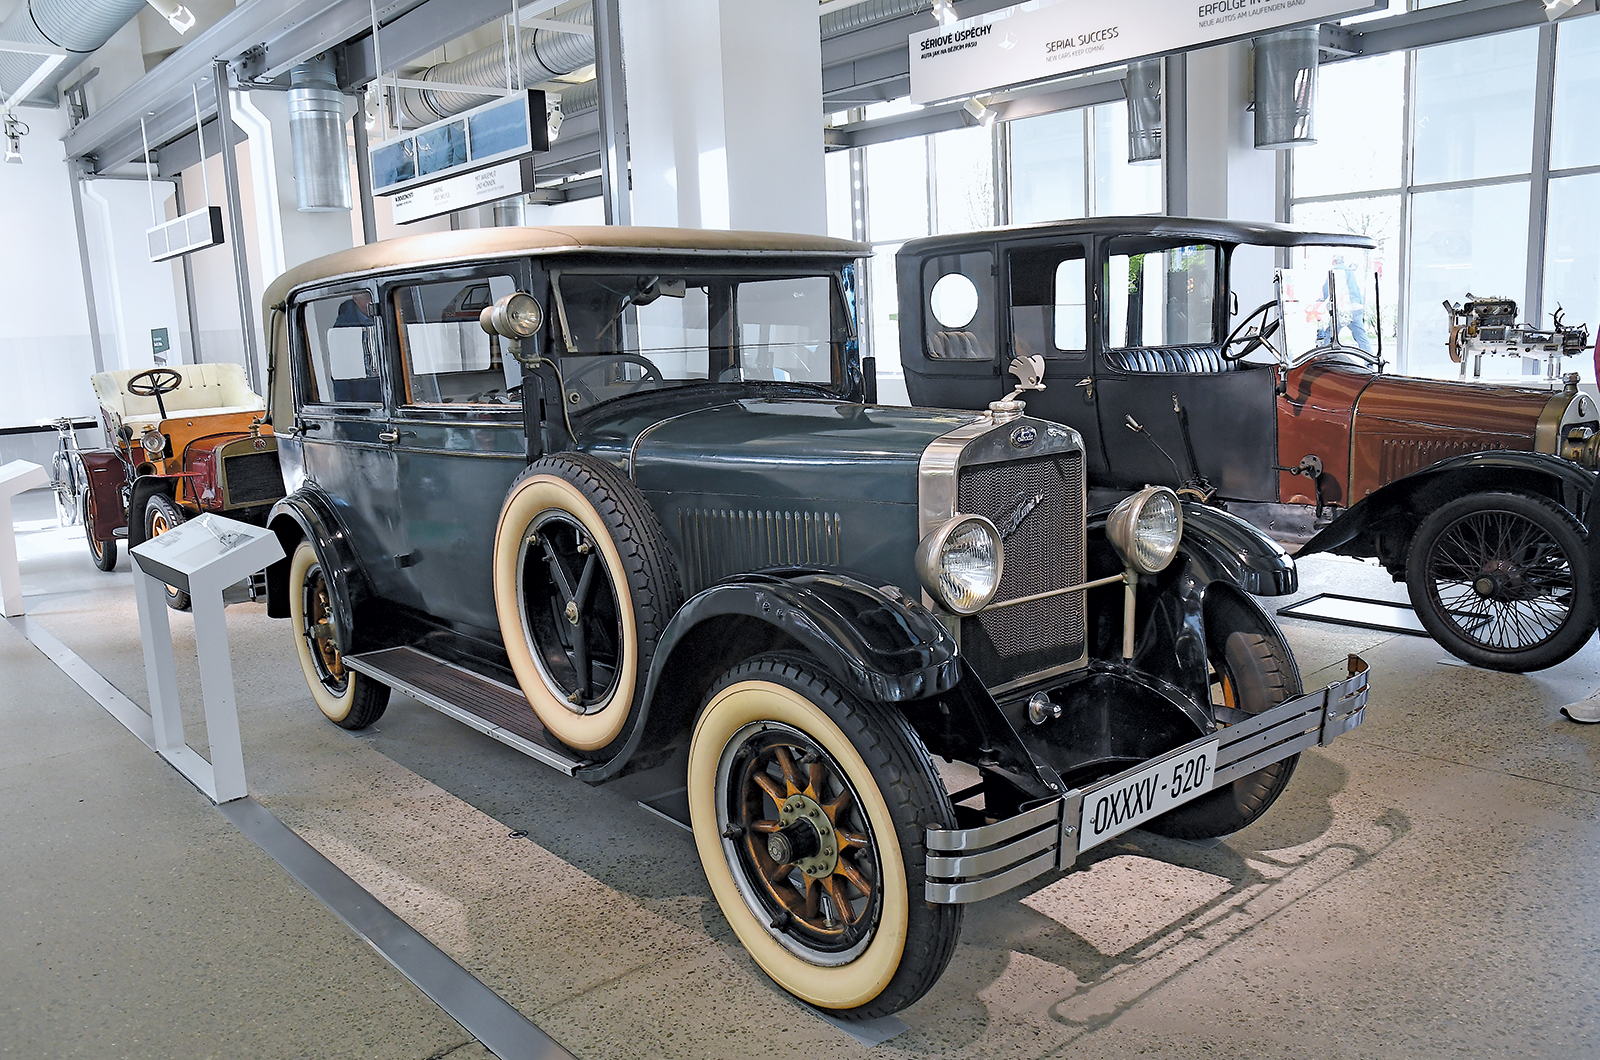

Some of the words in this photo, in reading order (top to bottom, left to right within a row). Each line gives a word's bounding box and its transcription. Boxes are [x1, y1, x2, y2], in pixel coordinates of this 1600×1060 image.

[1198, 0, 1246, 18] ERFOLGE
[1198, 19, 1215, 28] NEUE
[1215, 14, 1237, 24] AUTOS
[1237, 11, 1248, 19] AM
[1248, 3, 1286, 17] LAUFENDEN
[1286, 0, 1305, 8] BAND
[920, 32, 953, 51] SÉRIOVÉ
[954, 24, 993, 42] ÚSPĚCHY
[1045, 37, 1076, 54] SERIAL
[1077, 26, 1119, 46] SUCCESS
[920, 51, 932, 60] AUTA
[1045, 54, 1058, 63] NEW
[1057, 51, 1071, 60] CARS
[1071, 48, 1084, 57] KEEP
[1084, 44, 1105, 55] COMING
